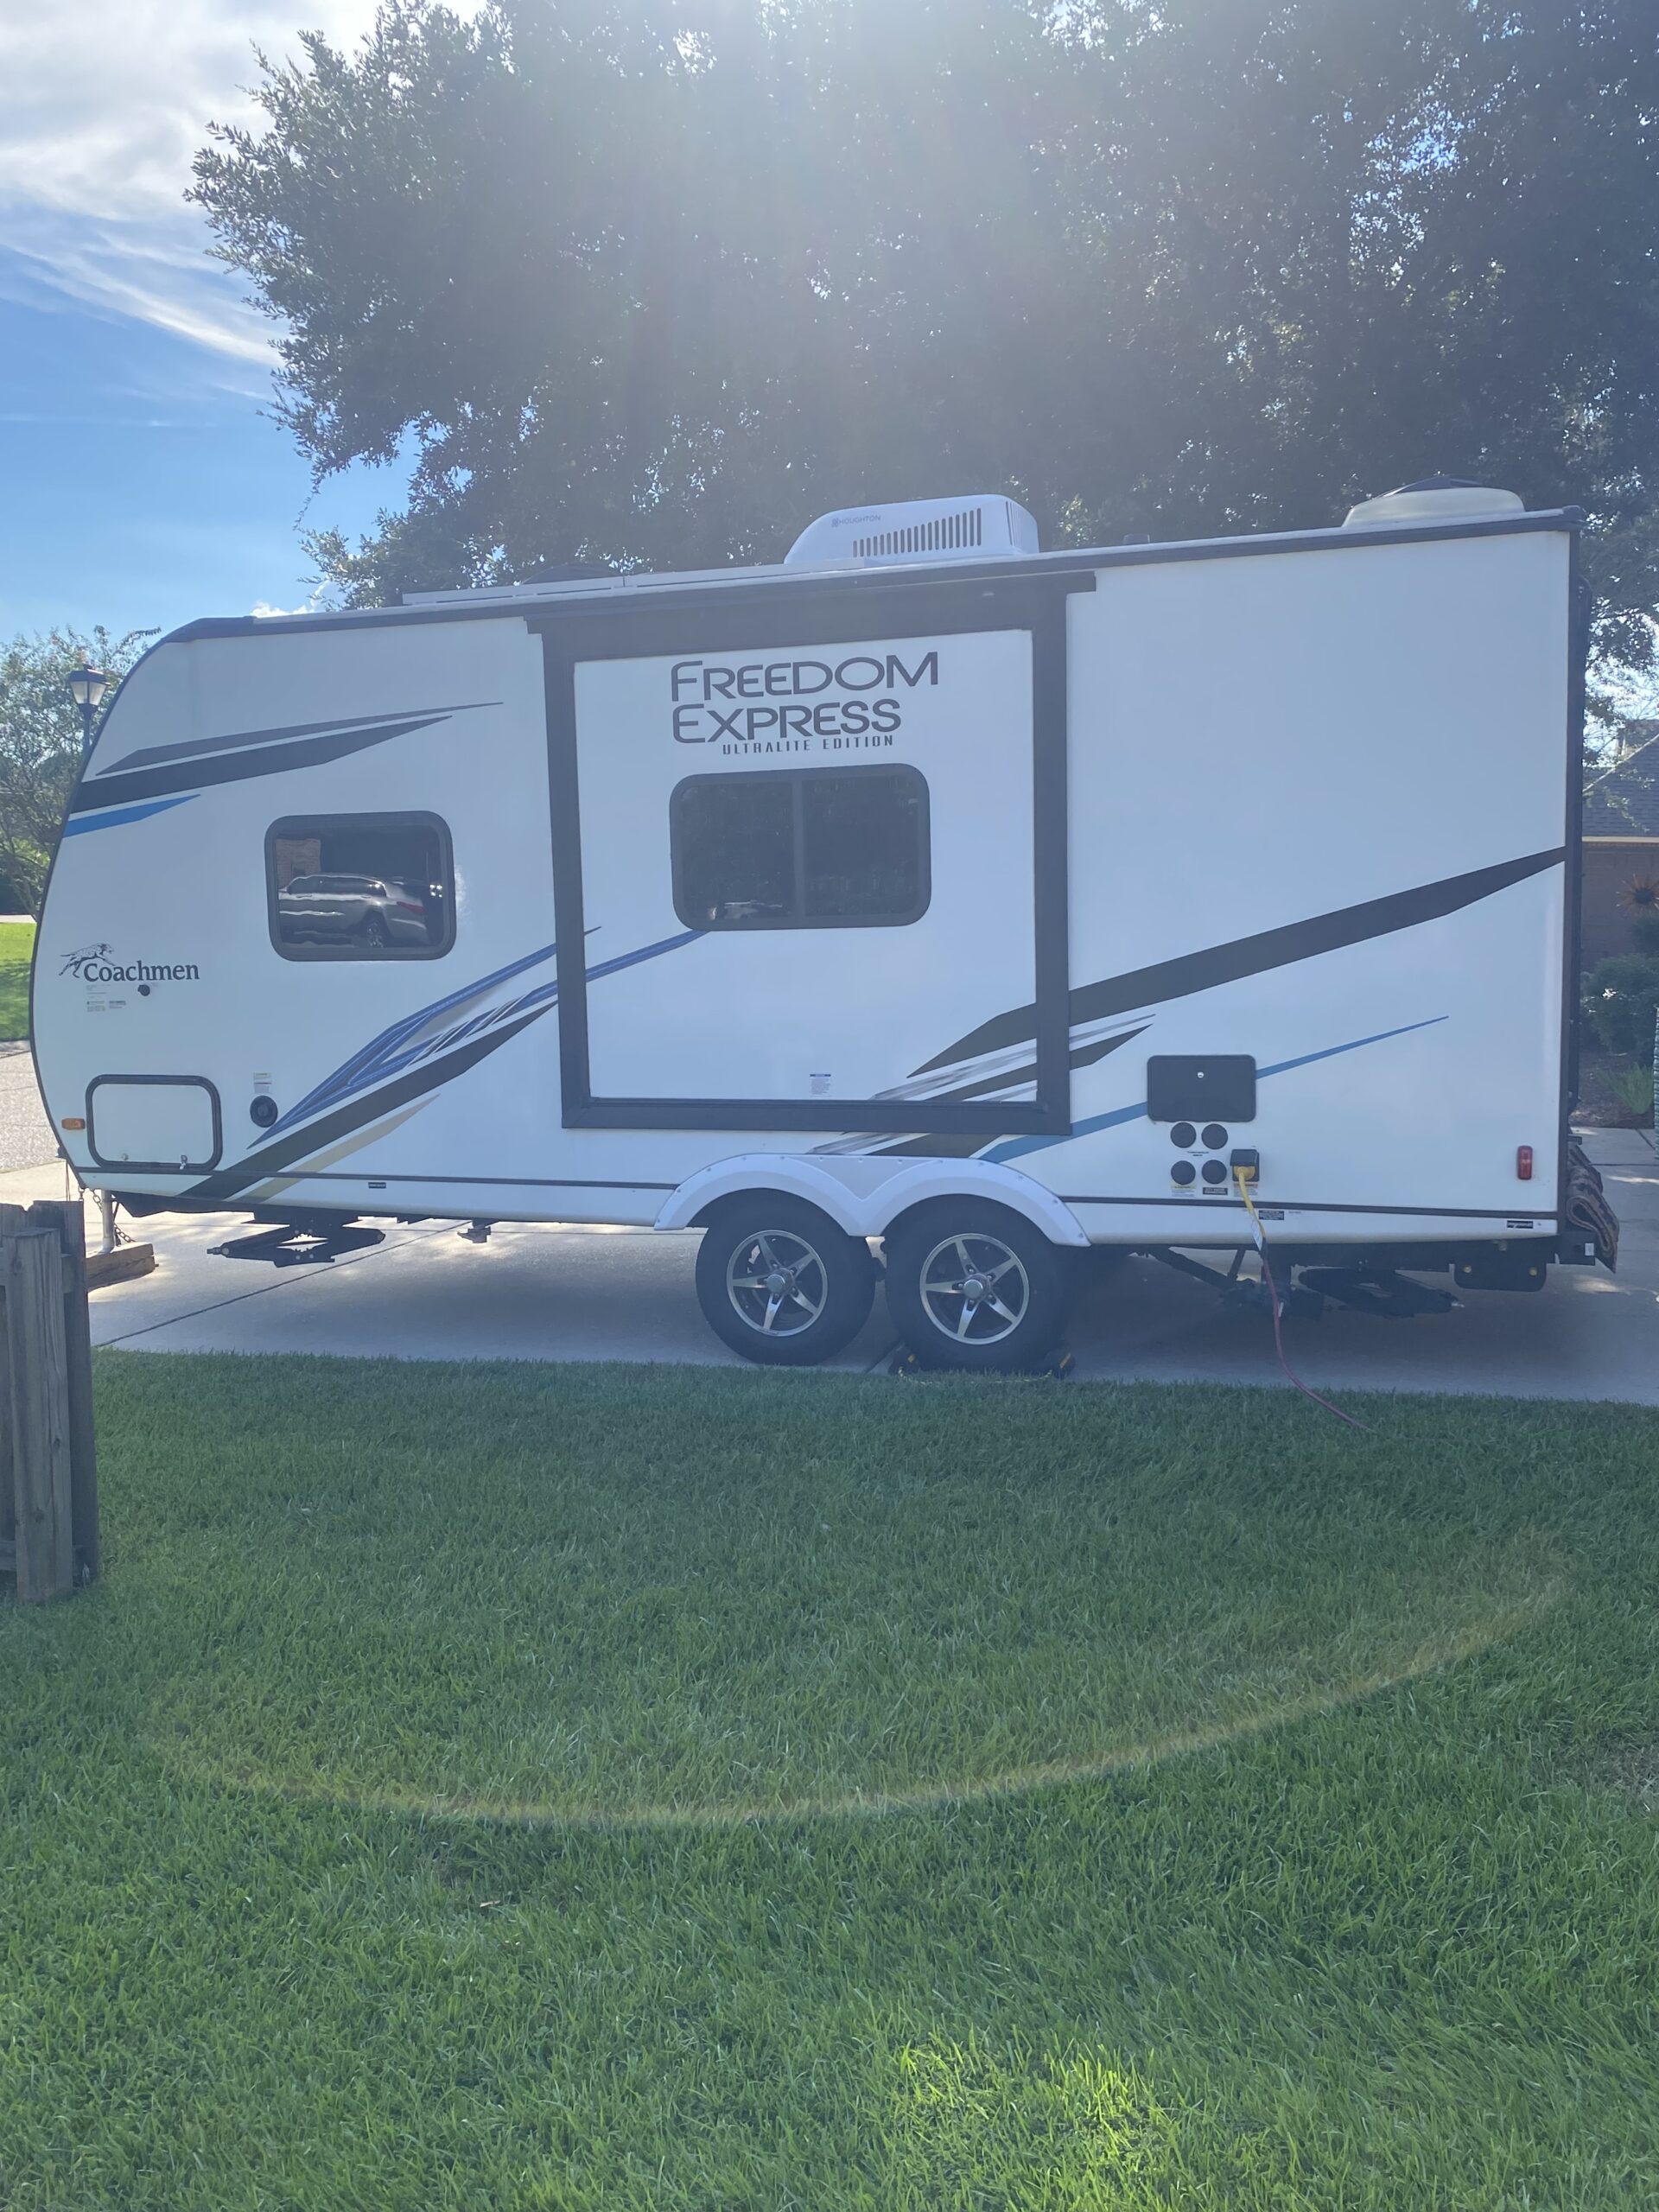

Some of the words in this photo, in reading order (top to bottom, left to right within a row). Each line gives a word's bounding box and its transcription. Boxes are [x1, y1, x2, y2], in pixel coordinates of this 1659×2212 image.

[839, 514, 881, 524] HOUGHTON
[671, 652, 938, 702] FREEDOM
[672, 698, 901, 743] EXPRESS
[722, 740, 810, 755] ULTRALITE
[823, 735, 893, 750] EDITION
[84, 960, 200, 982] Coachmen
